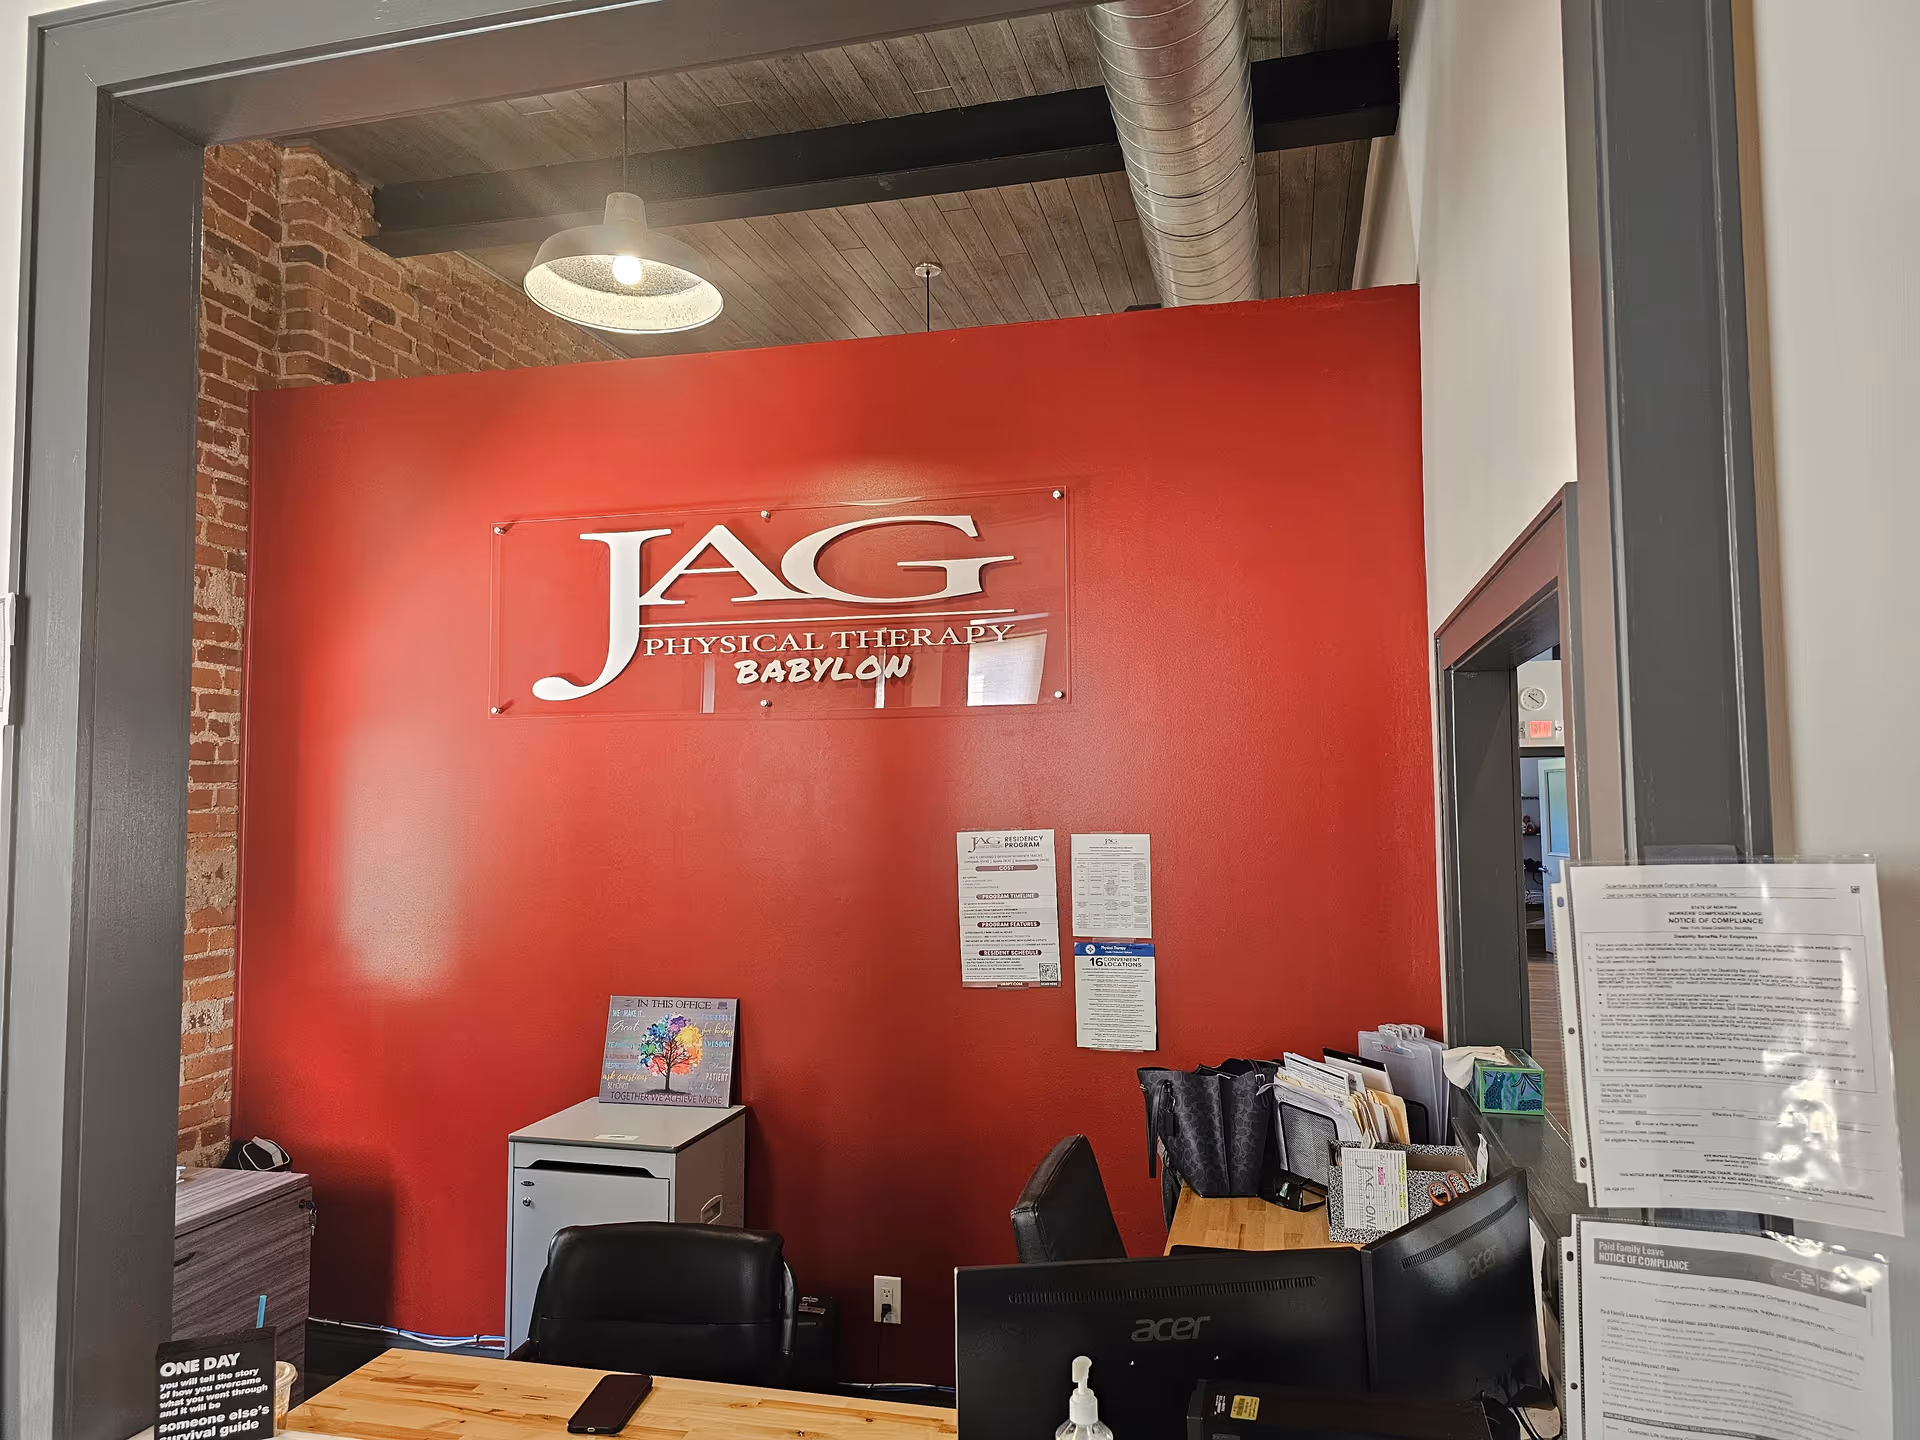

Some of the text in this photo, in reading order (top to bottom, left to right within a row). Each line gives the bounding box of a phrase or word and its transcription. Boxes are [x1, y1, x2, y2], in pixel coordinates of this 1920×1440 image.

[532, 514, 1015, 702] JAG
[643, 624, 1016, 657] PHYSICAL THERAPY
[735, 654, 913, 686] BABYLON
[1089, 957, 1103, 967] 16
[637, 999, 712, 1010] IN THIS OFFICE
[610, 1019, 640, 1034] Great
[610, 1091, 722, 1105] TOGETHER WE ACHIEVE MORE
[1598, 1241, 1665, 1257] Paid Family Leave
[1598, 1252, 1690, 1271] NOTICE OF COMPLIANCE
[1131, 1315, 1211, 1342] acer
[160, 1352, 241, 1377] ONE DAY
[160, 1368, 259, 1391] you will tell the story
[160, 1377, 261, 1400] of how you overcame
[160, 1384, 268, 1409] what you went through
[159, 1405, 270, 1433] someone else's
[160, 1401, 221, 1418] and it will be
[220, 1420, 260, 1437] guide
